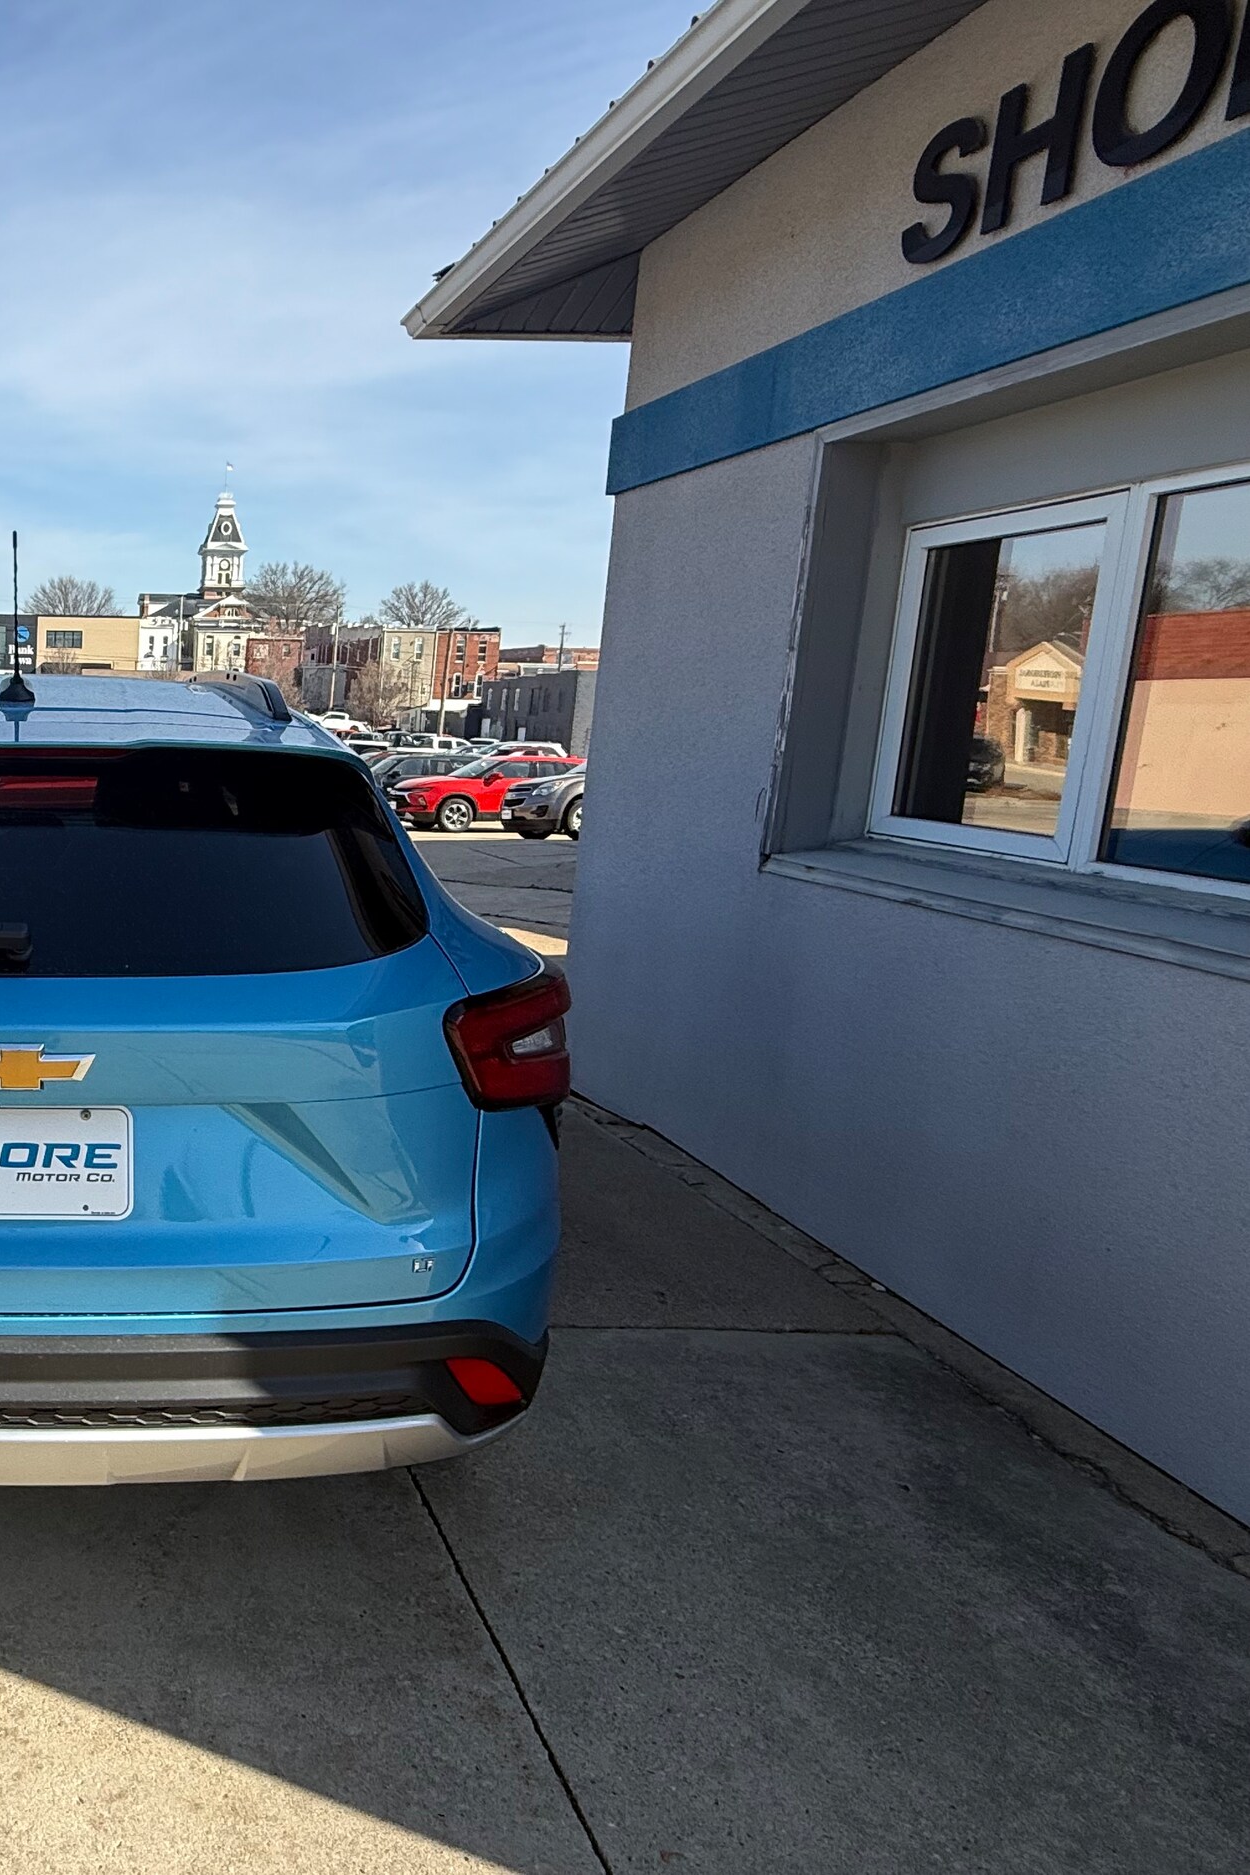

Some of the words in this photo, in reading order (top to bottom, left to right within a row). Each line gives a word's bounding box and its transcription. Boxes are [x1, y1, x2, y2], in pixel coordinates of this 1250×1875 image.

[901, 0, 1250, 264] SHO
[9, 655, 32, 665] Iwa
[16, 1172, 81, 1182] MOTOR
[86, 1172, 116, 1182] CO.
[412, 1257, 436, 1273] LT
